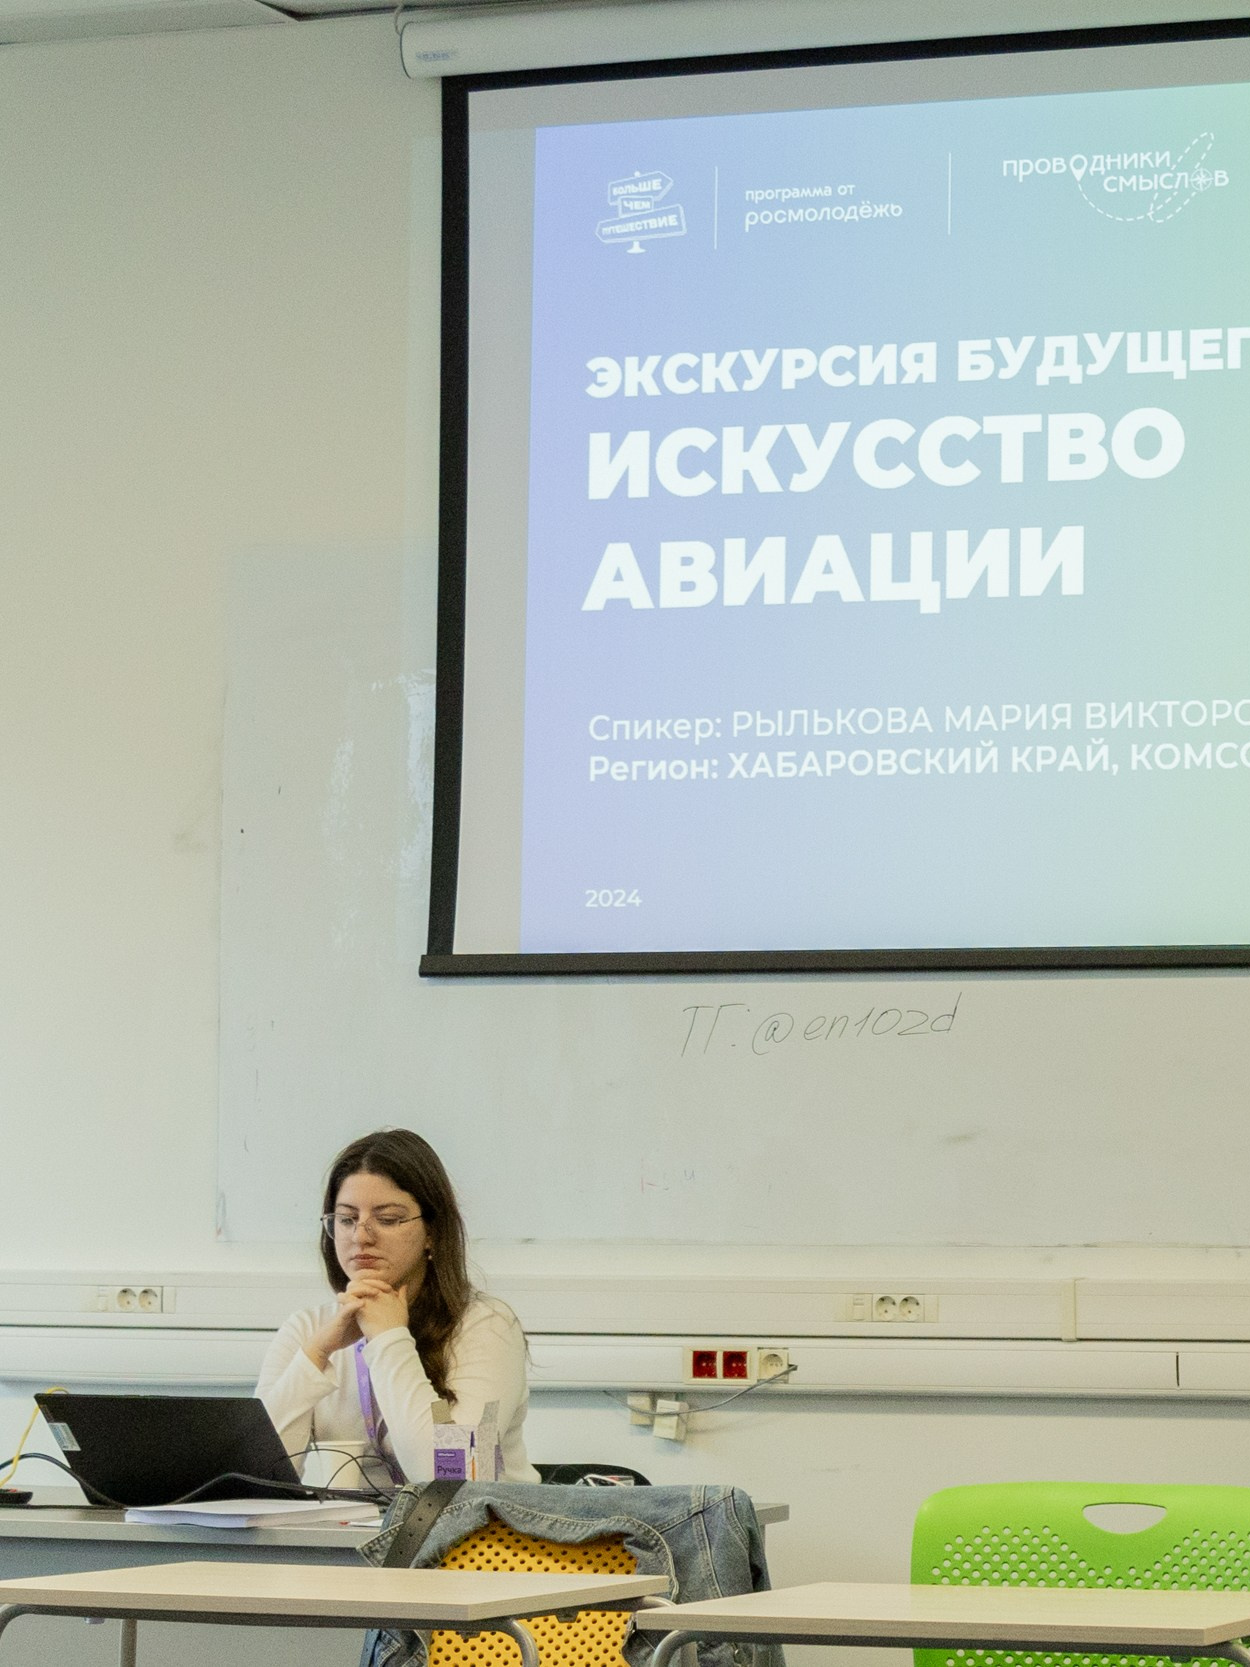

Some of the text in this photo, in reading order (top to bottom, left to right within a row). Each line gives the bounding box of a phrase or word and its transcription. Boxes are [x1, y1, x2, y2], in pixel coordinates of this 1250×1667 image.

[623, 200, 651, 210] ЧЕМ
[745, 184, 856, 203] программа от
[602, 214, 678, 235] ПУТЕШЕСТВИЕ
[745, 201, 904, 233] росмолодёжь
[585, 342, 938, 398] ЭКСКУРСИЯ
[588, 407, 1186, 500] ИСКУССТВО
[581, 526, 1085, 614] АВИАЦИИ
[588, 715, 722, 745] Спикер:
[733, 706, 932, 737] РЫЛЬКОВА
[945, 703, 1073, 732] МАРИЯ
[588, 756, 719, 782] Регион:
[728, 740, 999, 779] ХАБАРОВСКИЙ
[1011, 738, 1119, 775] КРАЙ,
[584, 888, 643, 908] 2024
[437, 1465, 462, 1476] Ручка
